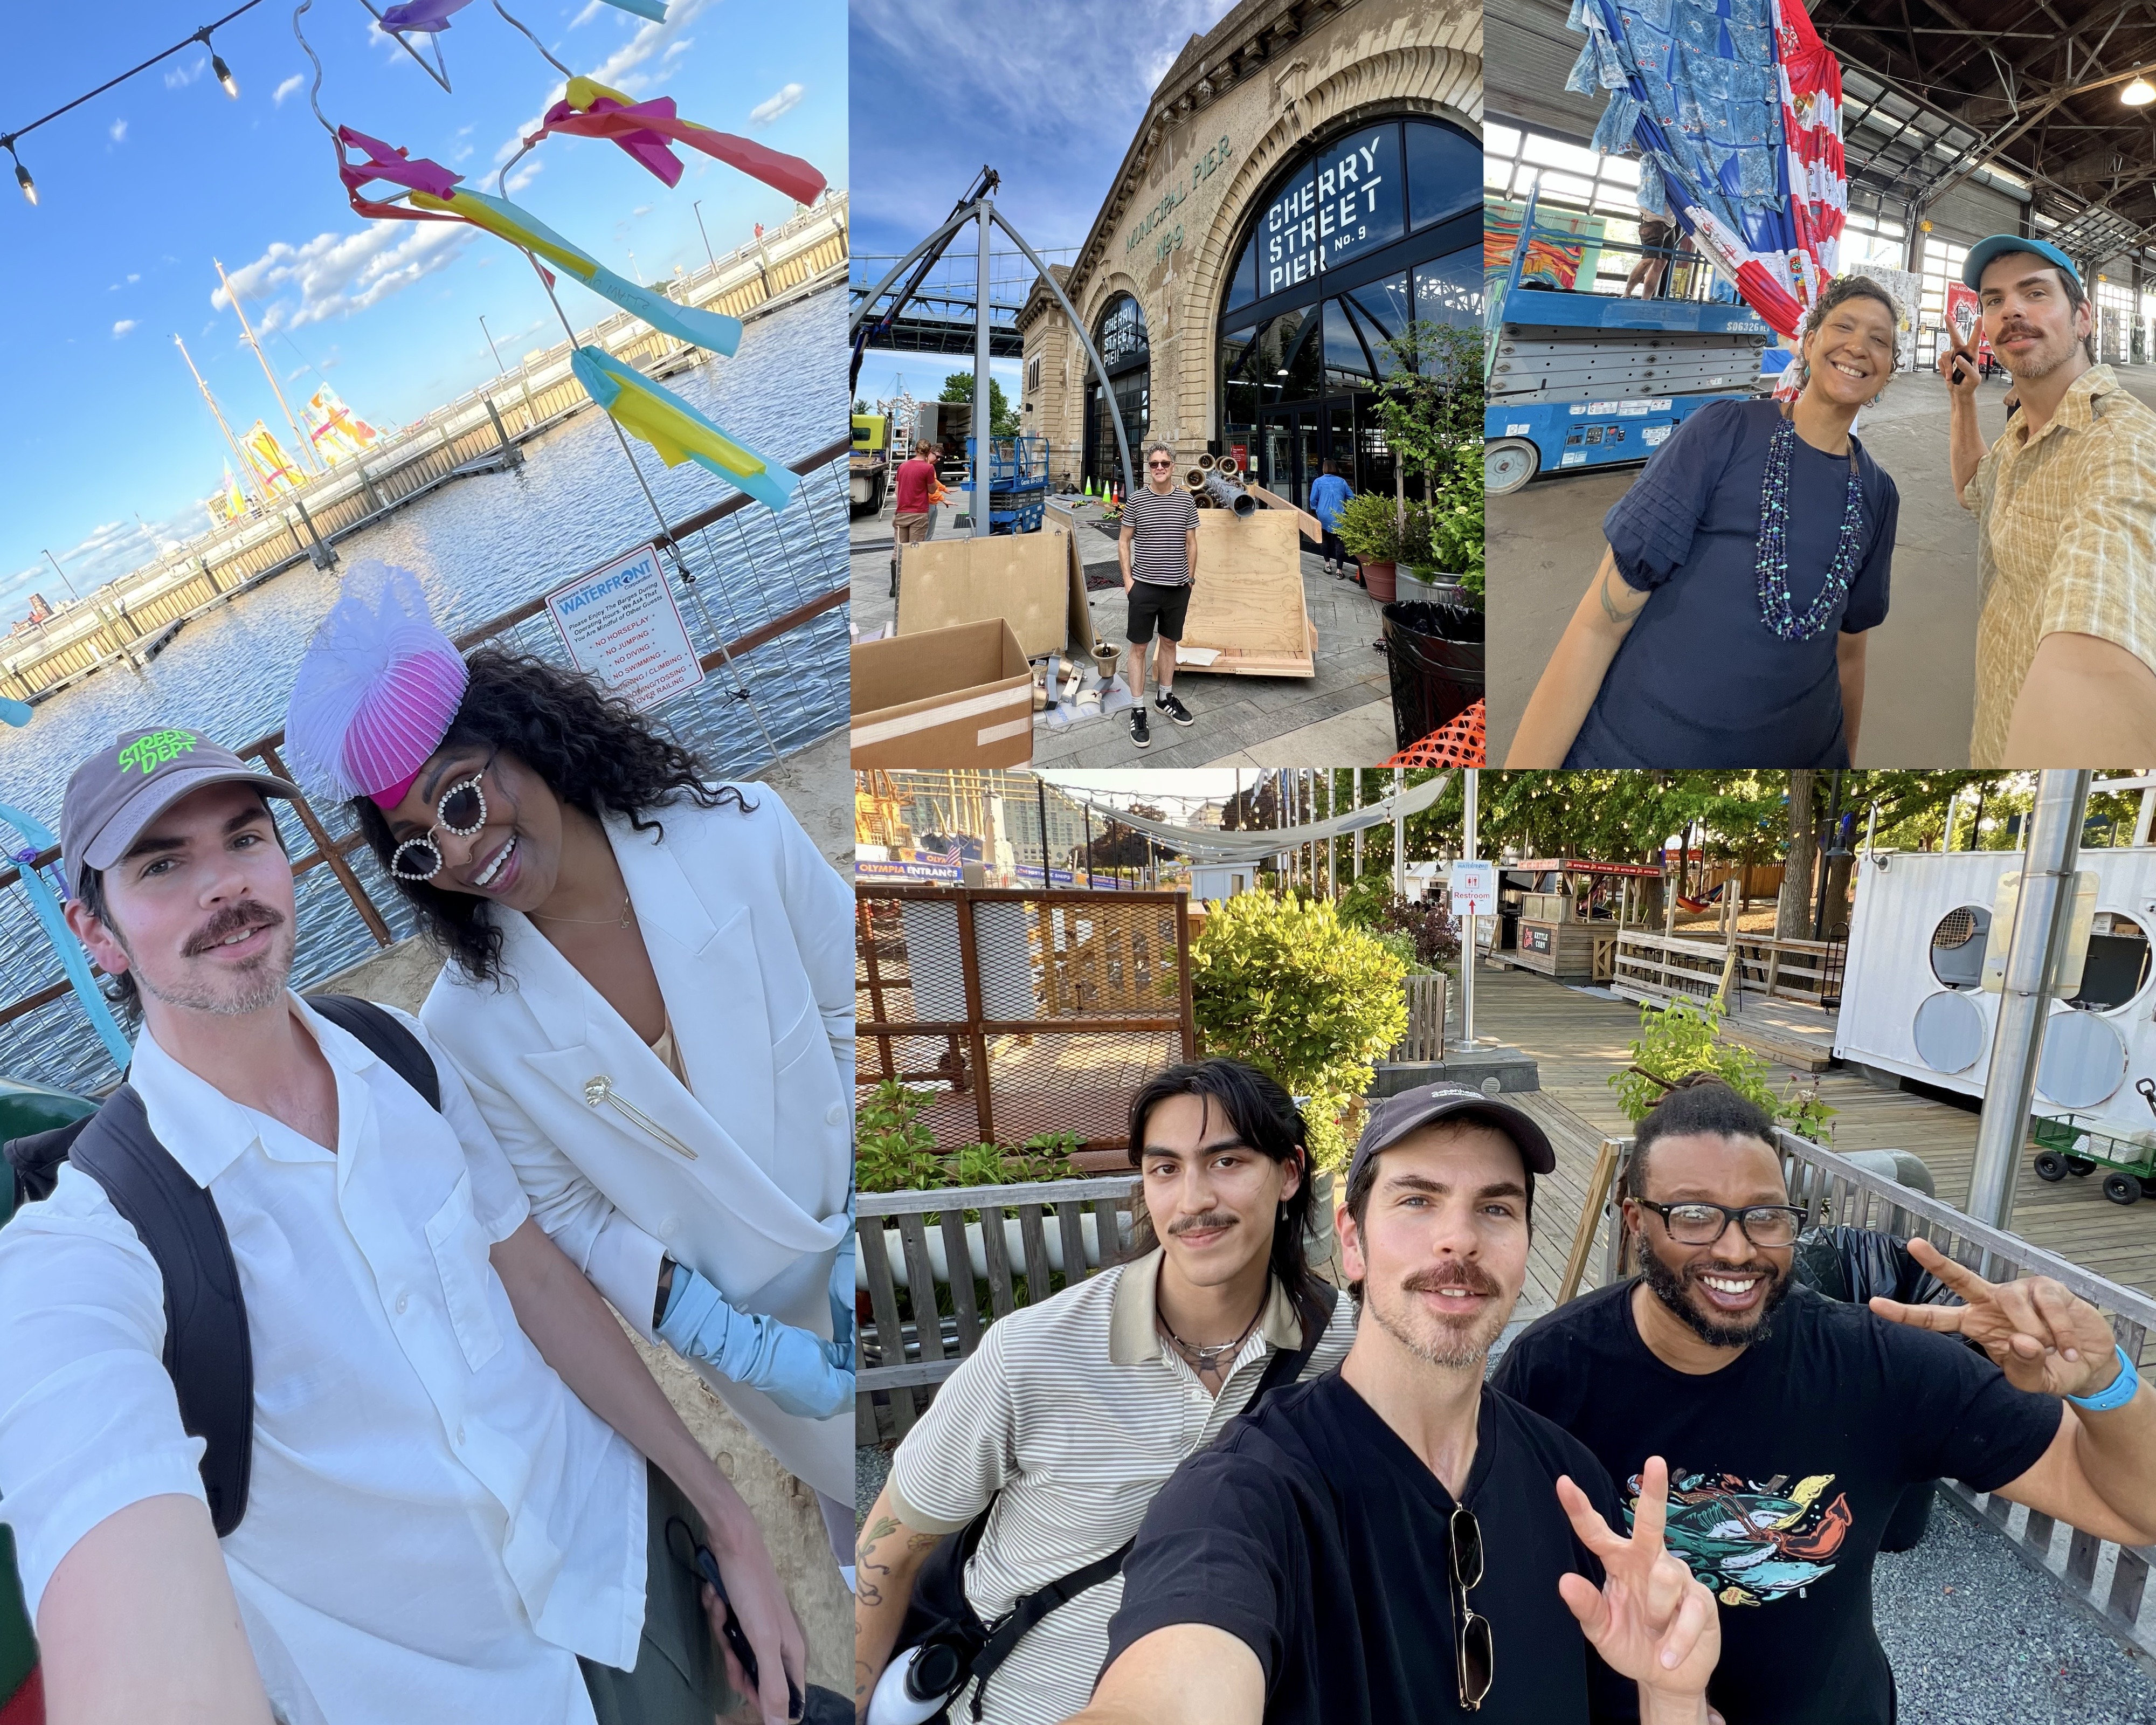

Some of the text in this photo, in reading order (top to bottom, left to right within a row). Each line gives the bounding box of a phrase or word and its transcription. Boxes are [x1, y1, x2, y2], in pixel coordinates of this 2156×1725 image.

[1127, 135, 1232, 253] MUNICIPAL PIER
[1269, 136, 1380, 232] CHERRY
[1270, 176, 1381, 264] STREET
[1270, 245, 1326, 294] PIER
[1358, 225, 1366, 240] 9
[1951, 285, 1975, 293] PHILADELP
[1104, 304, 1133, 335] CHERRY
[1104, 323, 1132, 351] STREET
[1104, 349, 1119, 368] PIER
[556, 584, 591, 605] Delaware River
[559, 559, 651, 616] WATERFRONT
[624, 574, 652, 590] Corporation
[569, 582, 658, 631] Please Enjoy The Barges During
[574, 619, 602, 636] Operating
[632, 597, 643, 606] Ask
[644, 590, 658, 599] That
[574, 635, 585, 643] You
[597, 617, 618, 632] Mindful
[626, 605, 641, 617] Other
[642, 595, 663, 608] Guests
[595, 616, 649, 647] NO HORSEPLAY
[605, 630, 649, 656] NO JUMPING
[613, 652, 661, 680] NO SWIMMING
[614, 644, 650, 666] NO DIVING
[649, 654, 682, 675] CLIMBING
[624, 666, 686, 700] ROWING/TOSSING
[636, 677, 685, 703] OVER RAILING
[141, 741, 197, 774] DEPT
[859, 864, 958, 877] OLYMPIA ENTRANCE
[927, 855, 962, 867] OLYMA
[1534, 932, 1548, 941] KETTLE
[1536, 941, 1545, 949] CORN
